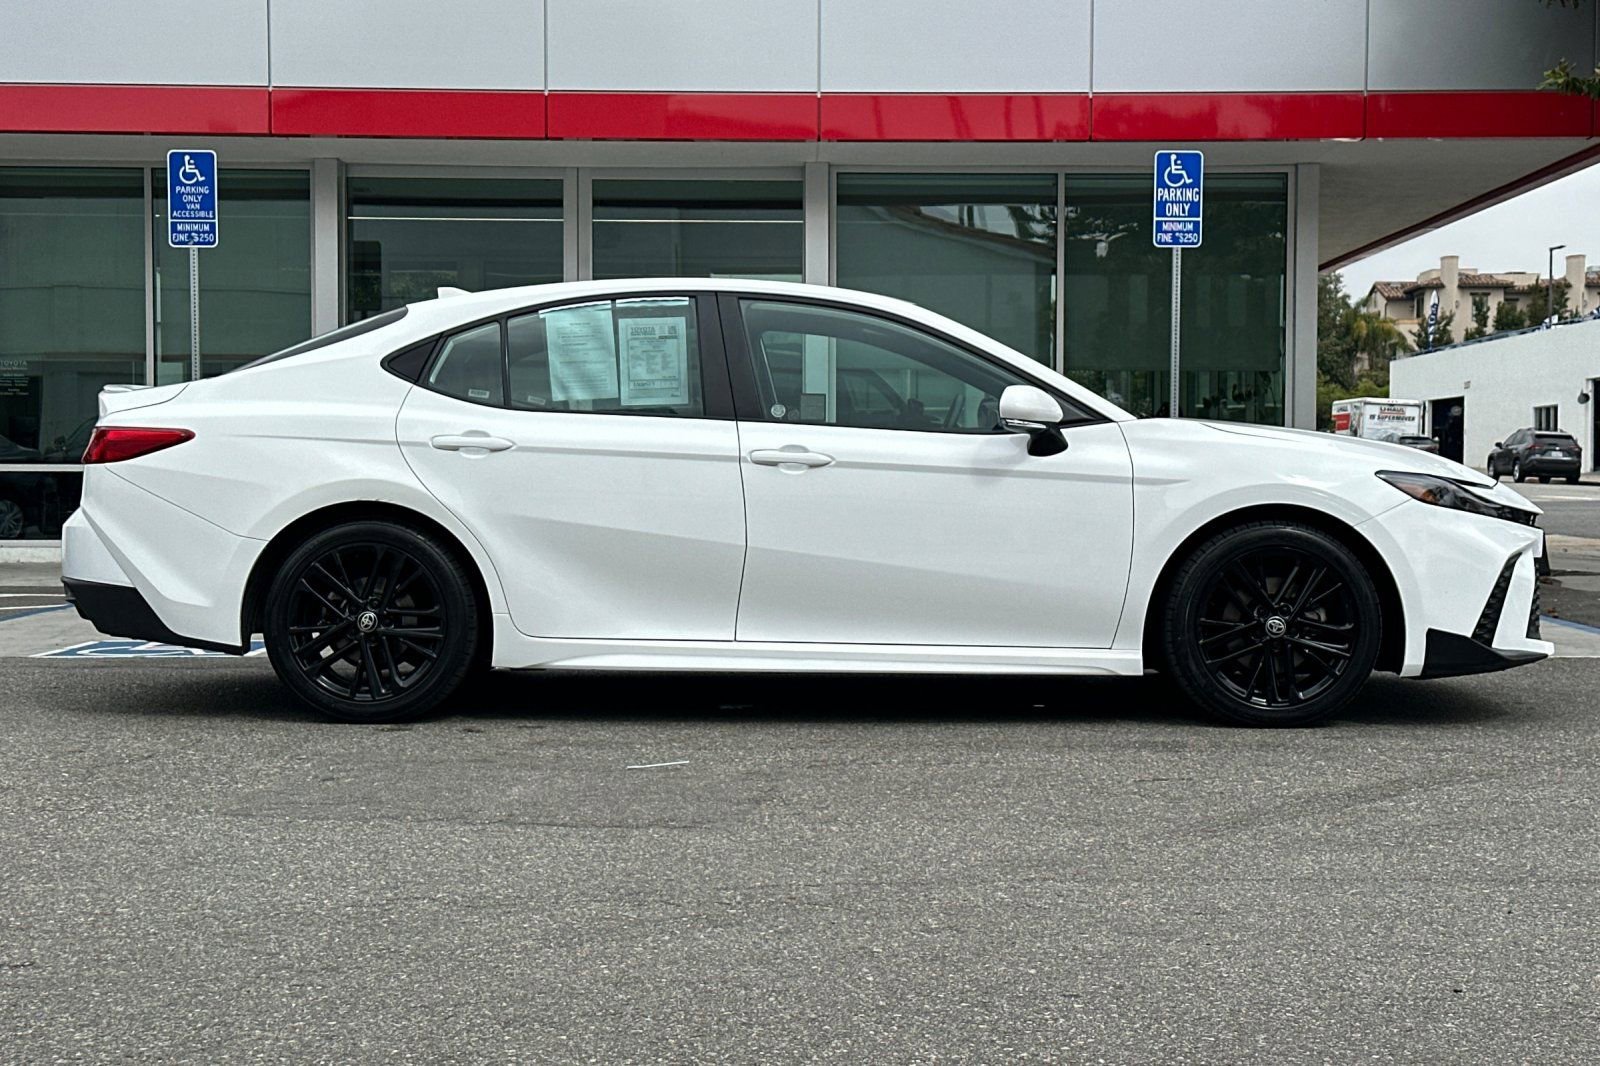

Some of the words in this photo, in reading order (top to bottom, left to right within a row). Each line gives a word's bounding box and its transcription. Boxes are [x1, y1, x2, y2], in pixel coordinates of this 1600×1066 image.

[175, 185, 210, 194] PARKING
[182, 194, 203, 203] ONLY
[1157, 187, 1200, 202] PARKING
[172, 210, 214, 218] ACCESSIBLE
[1165, 203, 1191, 217] ONLY
[176, 223, 210, 232] MINIMUM
[1162, 221, 1194, 232] MINIMUM
[172, 233, 189, 242] FINE
[1157, 232, 1173, 243] FINE
